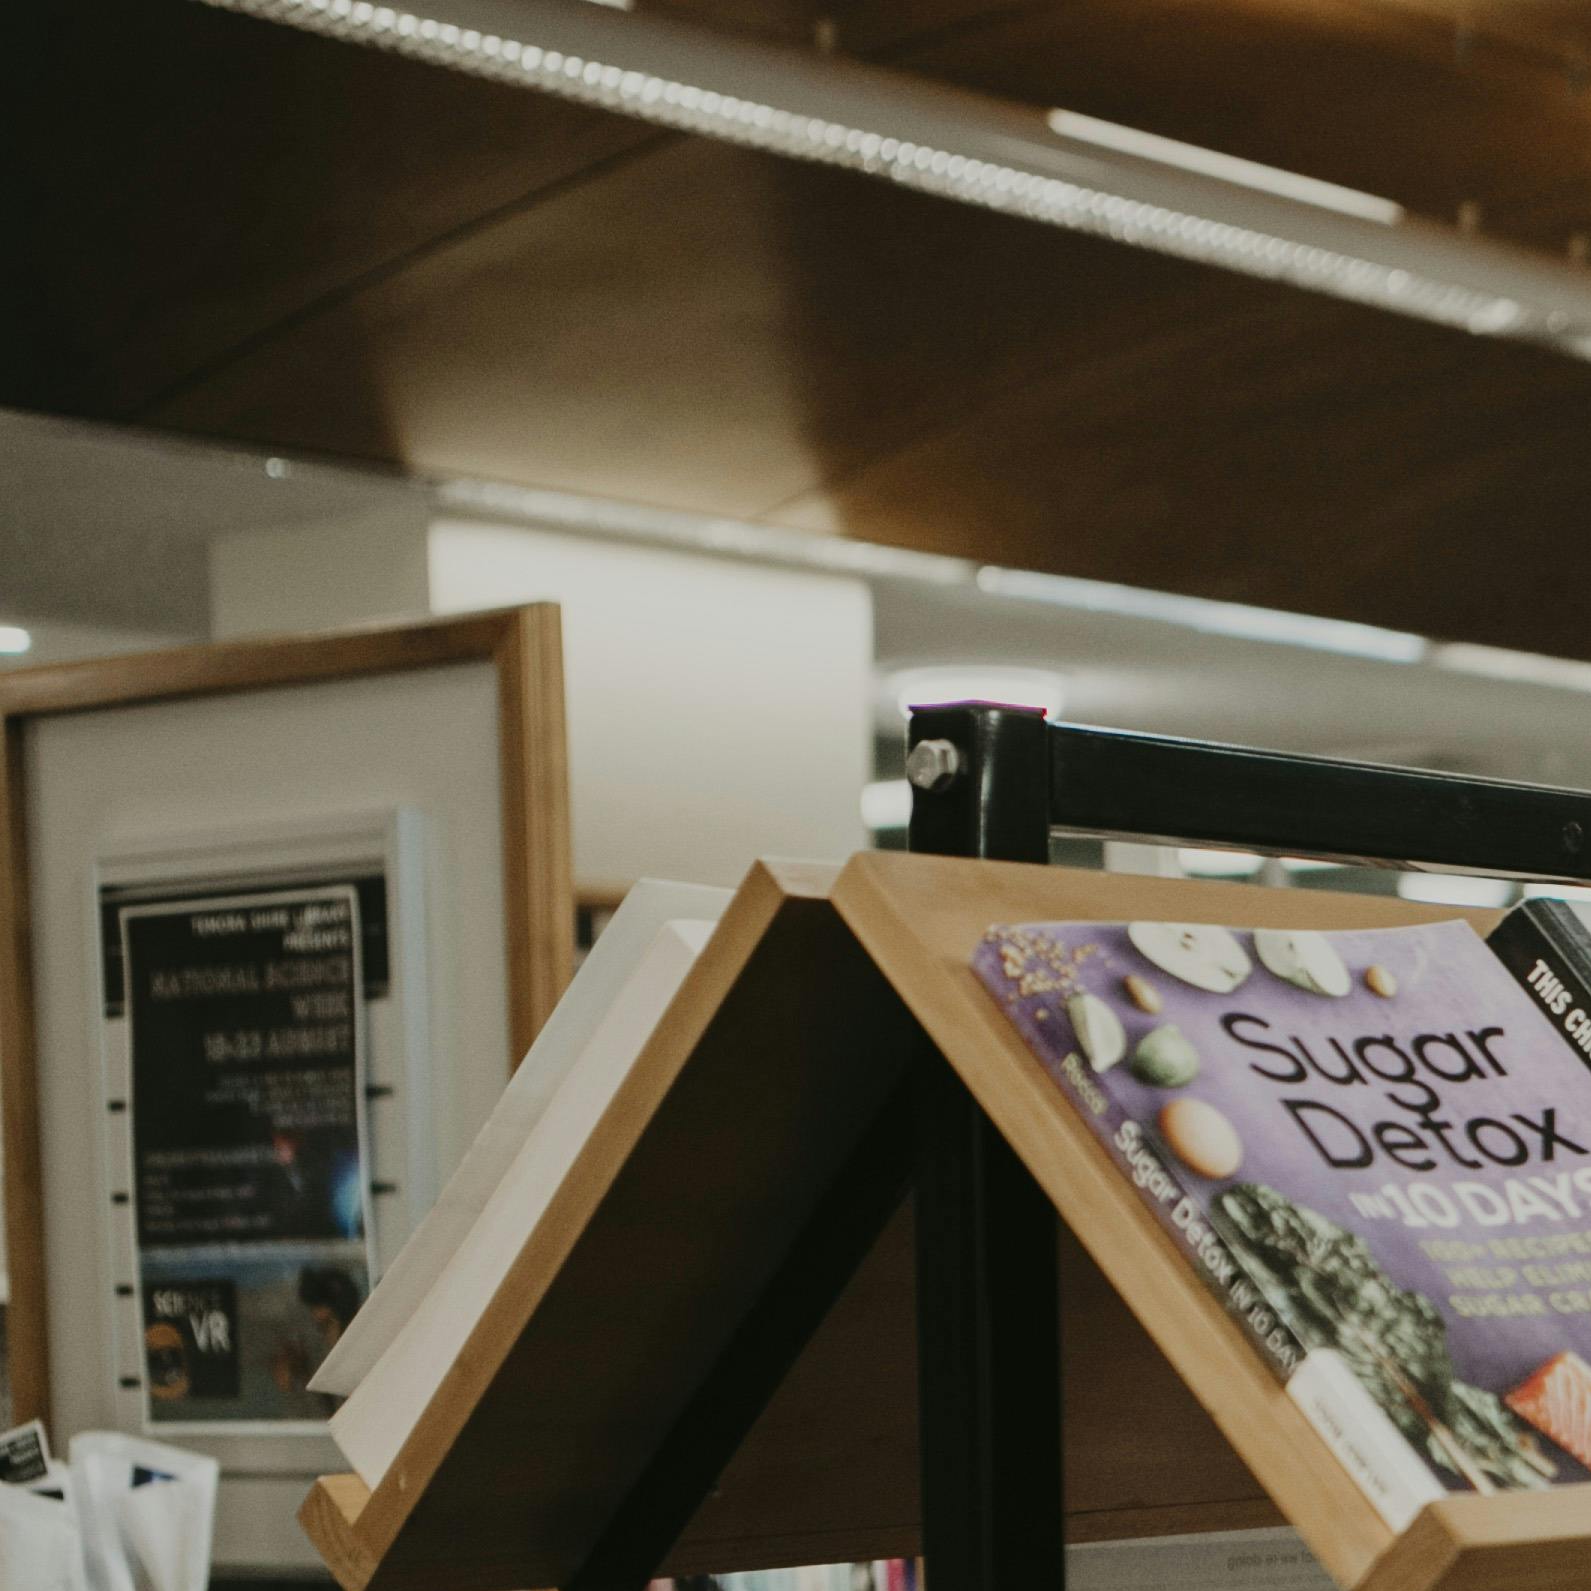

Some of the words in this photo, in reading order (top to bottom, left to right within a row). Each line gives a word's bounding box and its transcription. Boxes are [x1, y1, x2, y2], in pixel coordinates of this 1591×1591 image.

[1526, 959, 1576, 1016] THIS
[1220, 1012, 1509, 1115] Sugar
[1281, 1098, 1590, 1172] Detox
[1115, 1121, 1181, 1202] Sugar
[1171, 1197, 1233, 1282] Detox
[1385, 1182, 1461, 1228] 10
[190, 1310, 231, 1352] VR
